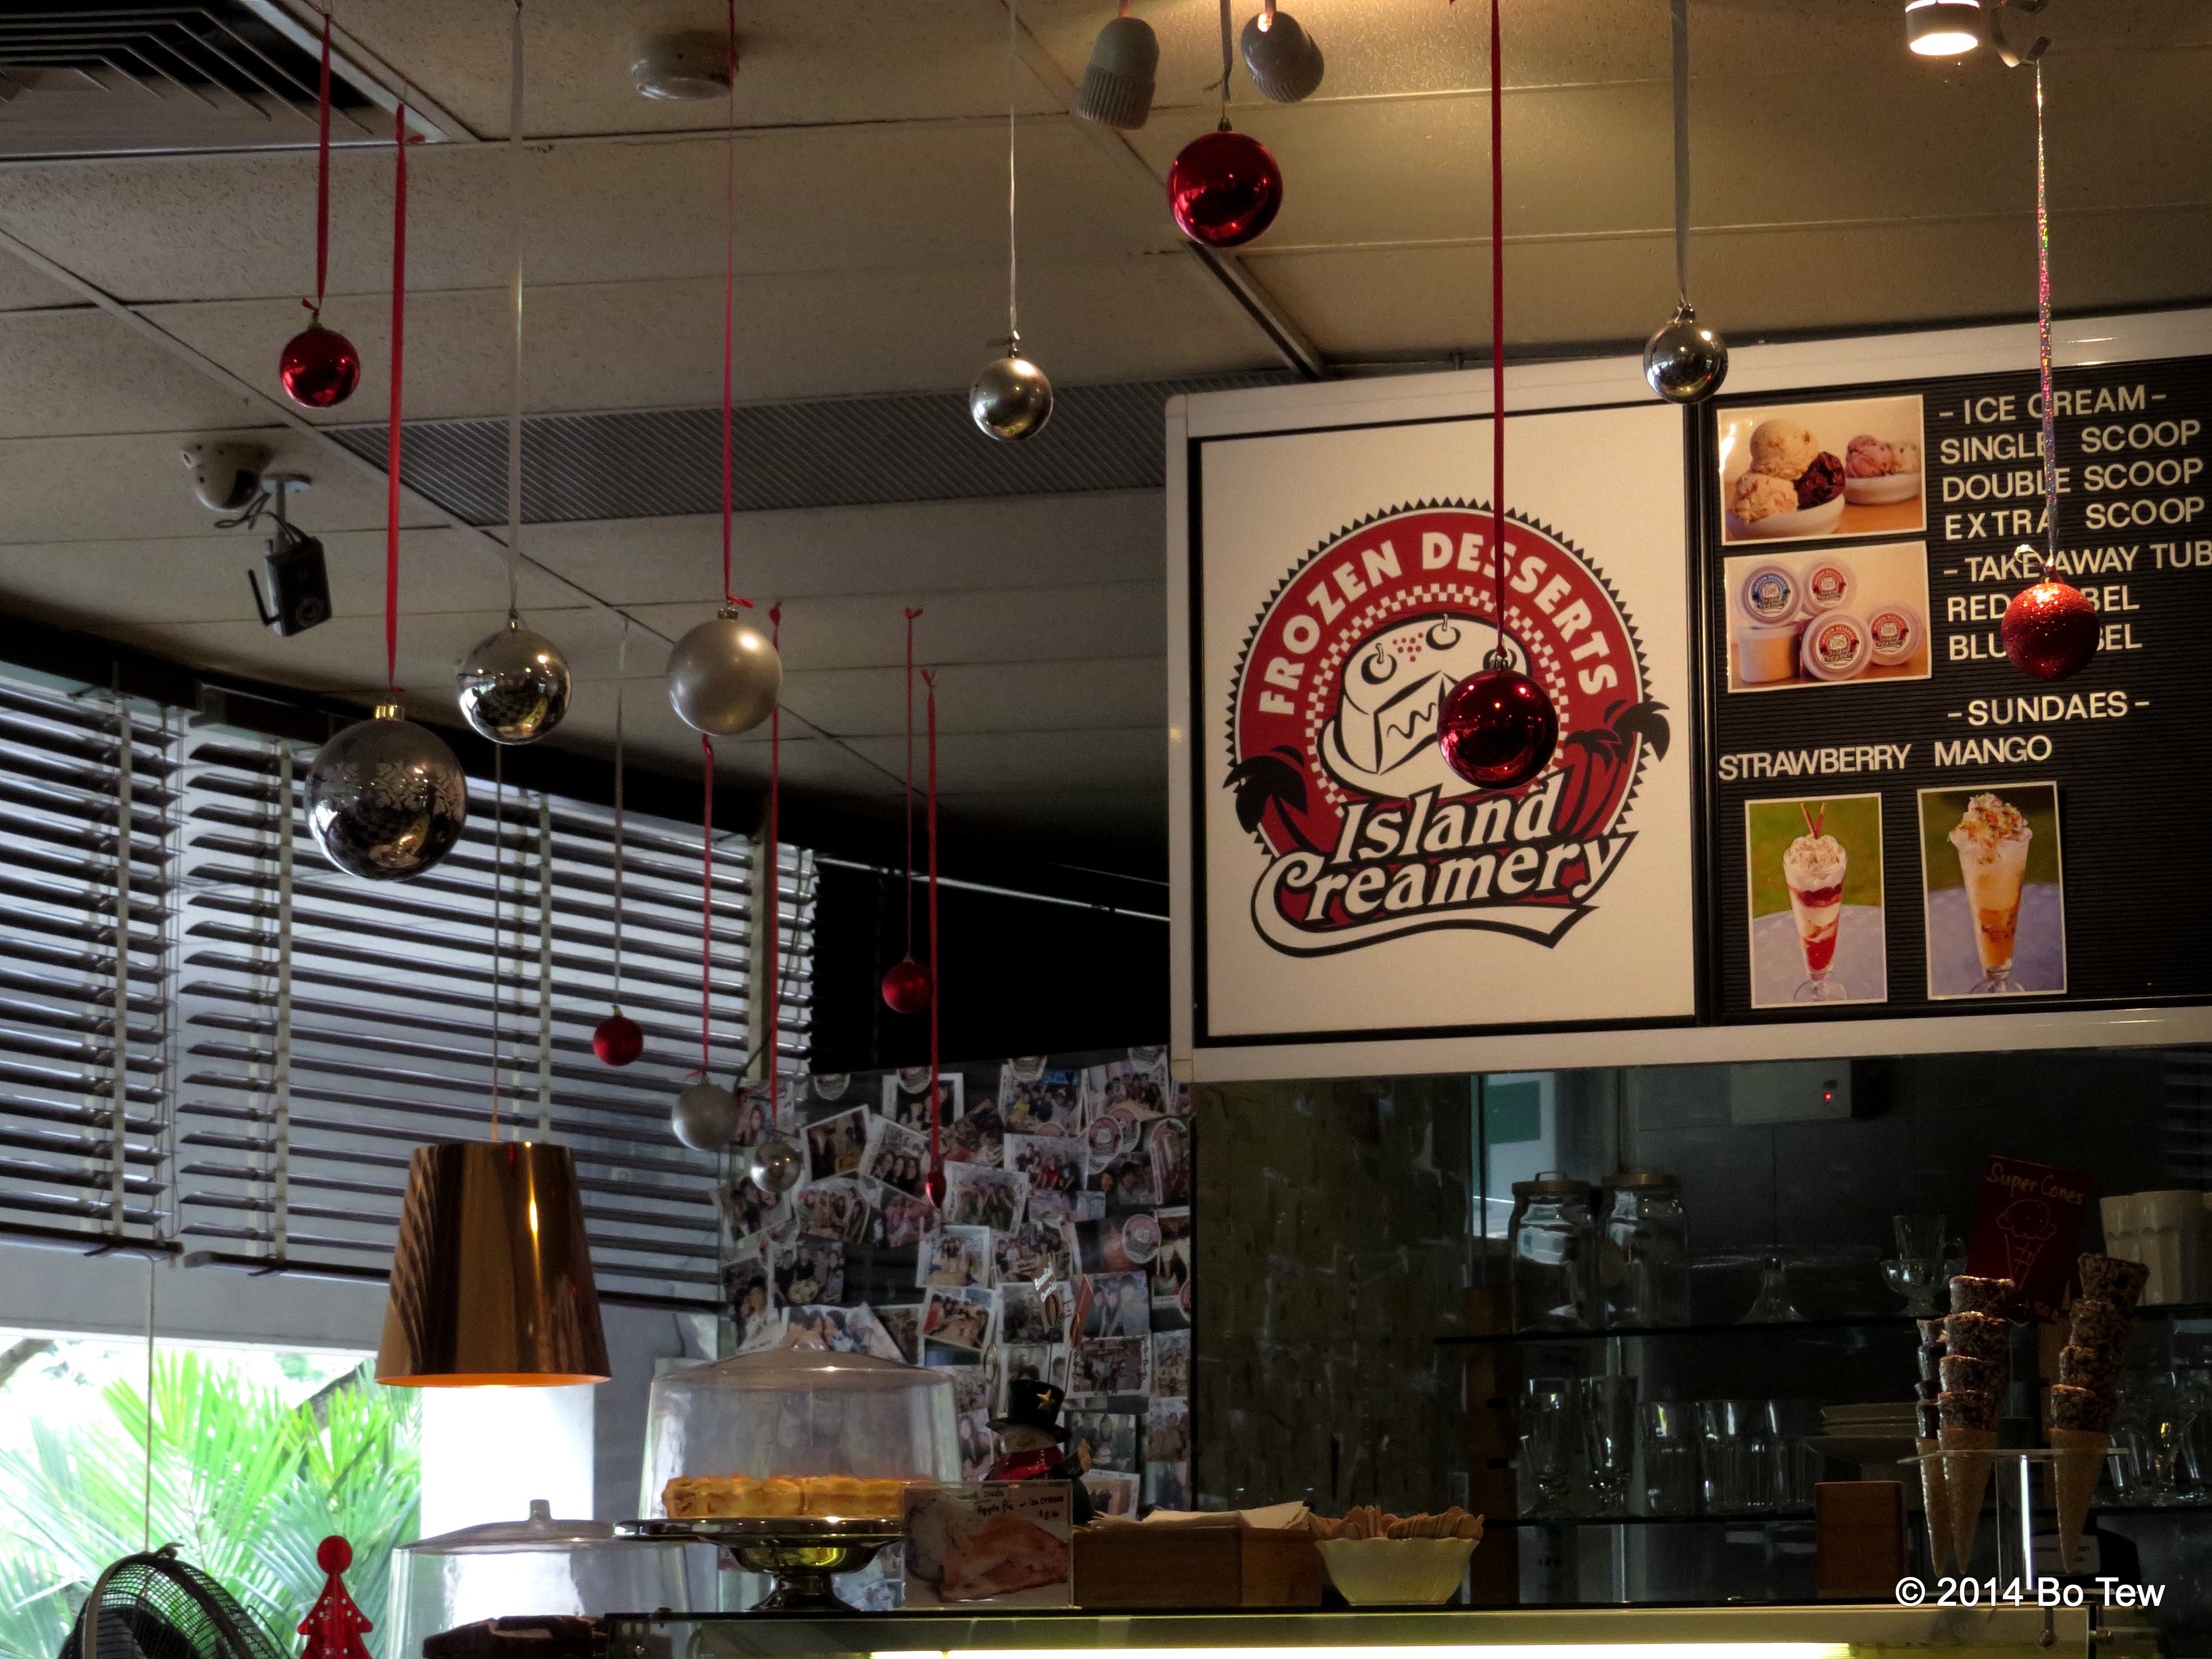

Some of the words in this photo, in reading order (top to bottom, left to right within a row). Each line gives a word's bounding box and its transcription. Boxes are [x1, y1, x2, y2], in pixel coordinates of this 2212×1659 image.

[1965, 395, 2016, 424] ICE
[2028, 385, 2146, 419] CREAM
[2081, 420, 2200, 453] SCOOP
[1942, 467, 2072, 502] DOUBLE
[2084, 458, 2204, 491] SCOOP
[2086, 497, 2205, 530] SCOOP
[2056, 545, 2139, 575] AWAY
[1259, 540, 1402, 716] FROZEN
[1422, 531, 1618, 696] DESSERTS
[1948, 593, 2011, 623] RED
[1949, 634, 2007, 661] BLU
[1967, 691, 2128, 726] SUNDAES
[1718, 743, 1912, 781] STRAWBERRY
[1934, 735, 2053, 767] MANGO
[1329, 773, 1566, 866] Island
[1252, 831, 1634, 937] Creamery
[1986, 1162, 2038, 1197] Super
[2041, 1173, 2085, 1205] Cones
